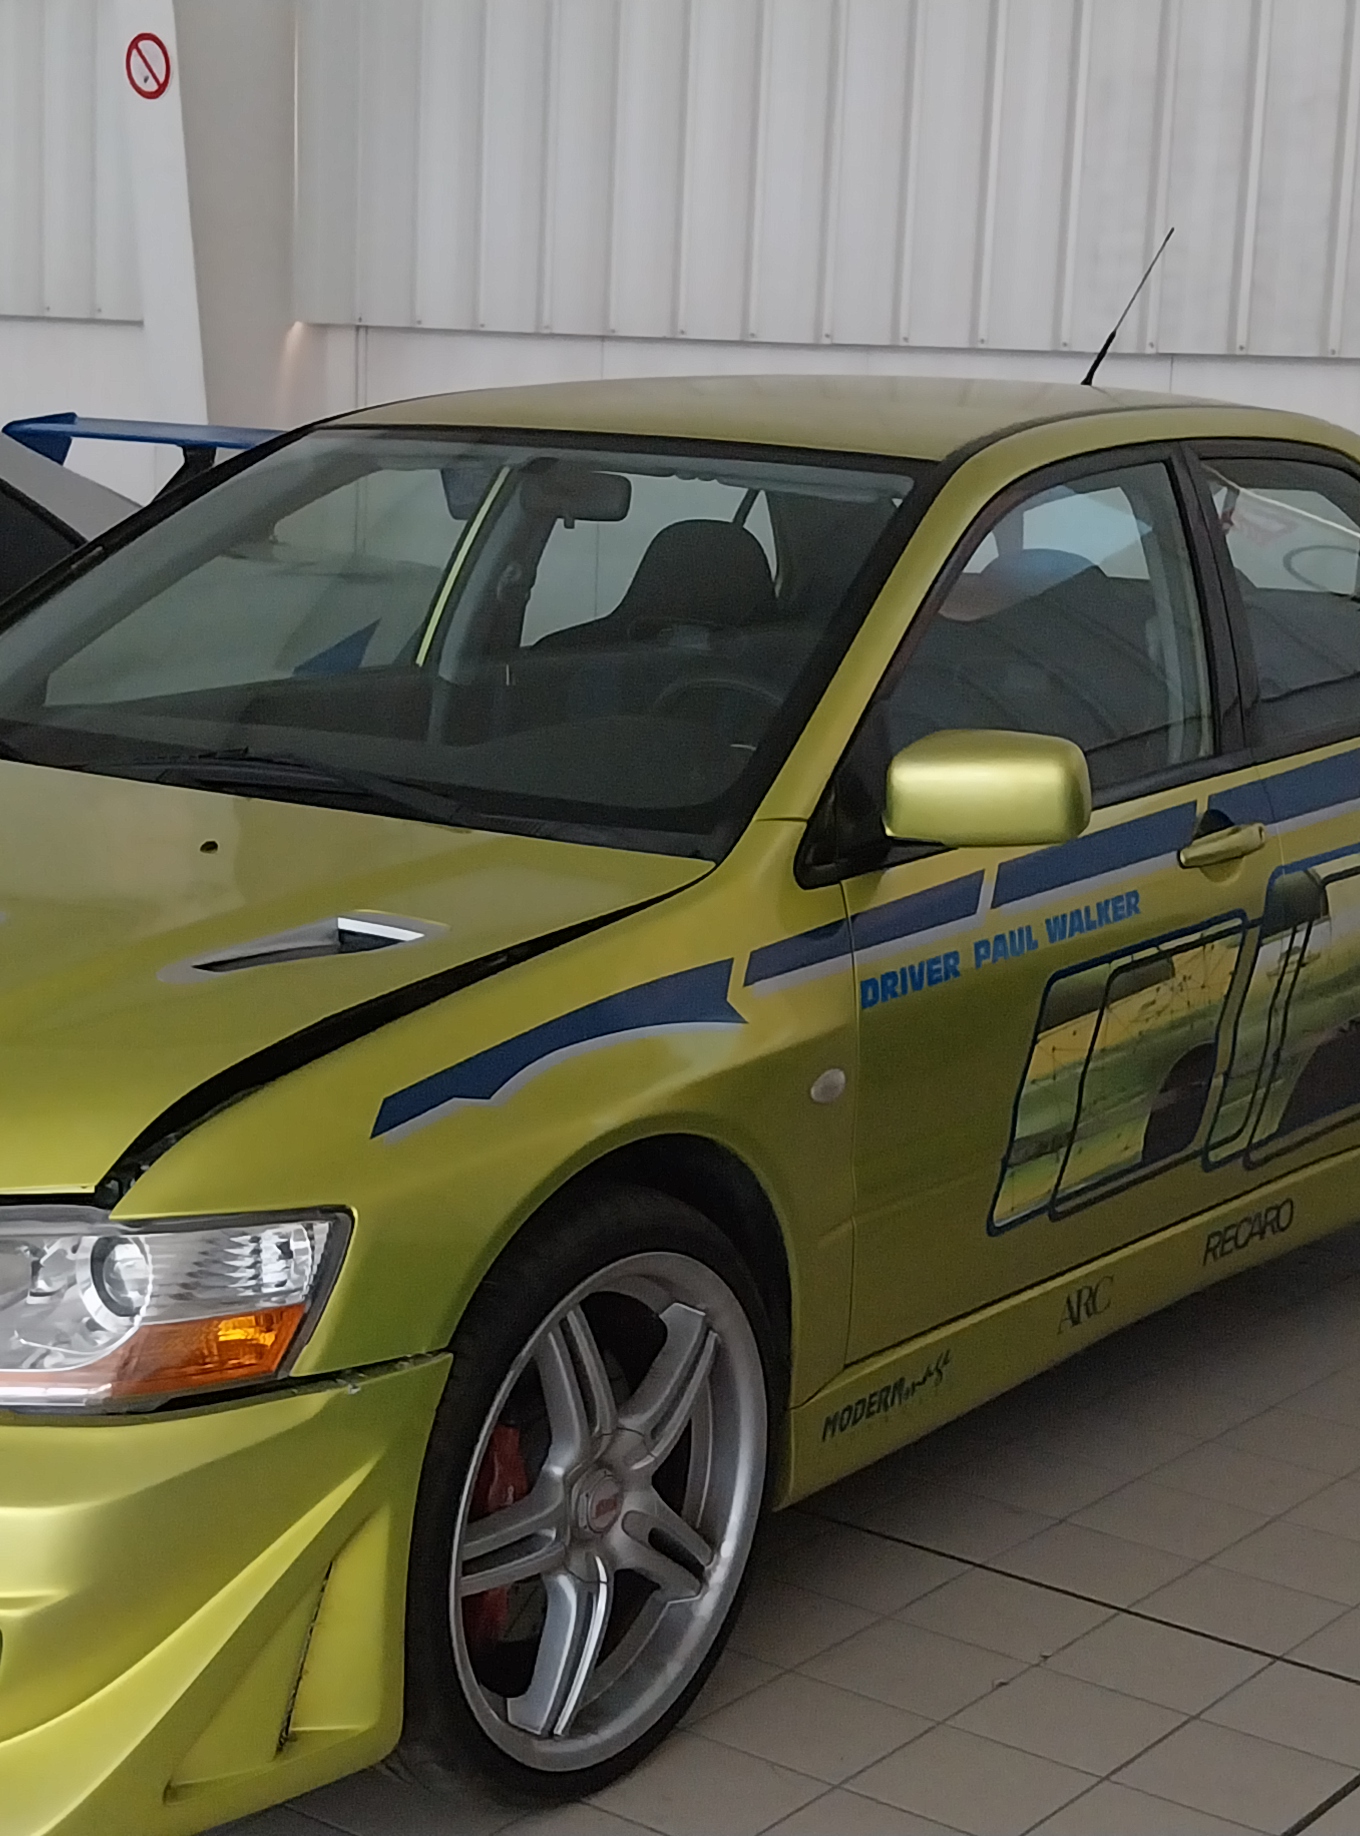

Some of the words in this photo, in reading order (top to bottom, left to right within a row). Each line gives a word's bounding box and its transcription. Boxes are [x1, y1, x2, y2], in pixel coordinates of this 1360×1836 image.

[860, 950, 961, 1009] DRIVER
[973, 925, 1038, 969] PAUL
[1045, 890, 1140, 944] WALKER
[1203, 1198, 1294, 1266] RECARO
[1057, 1275, 1114, 1335] ARC
